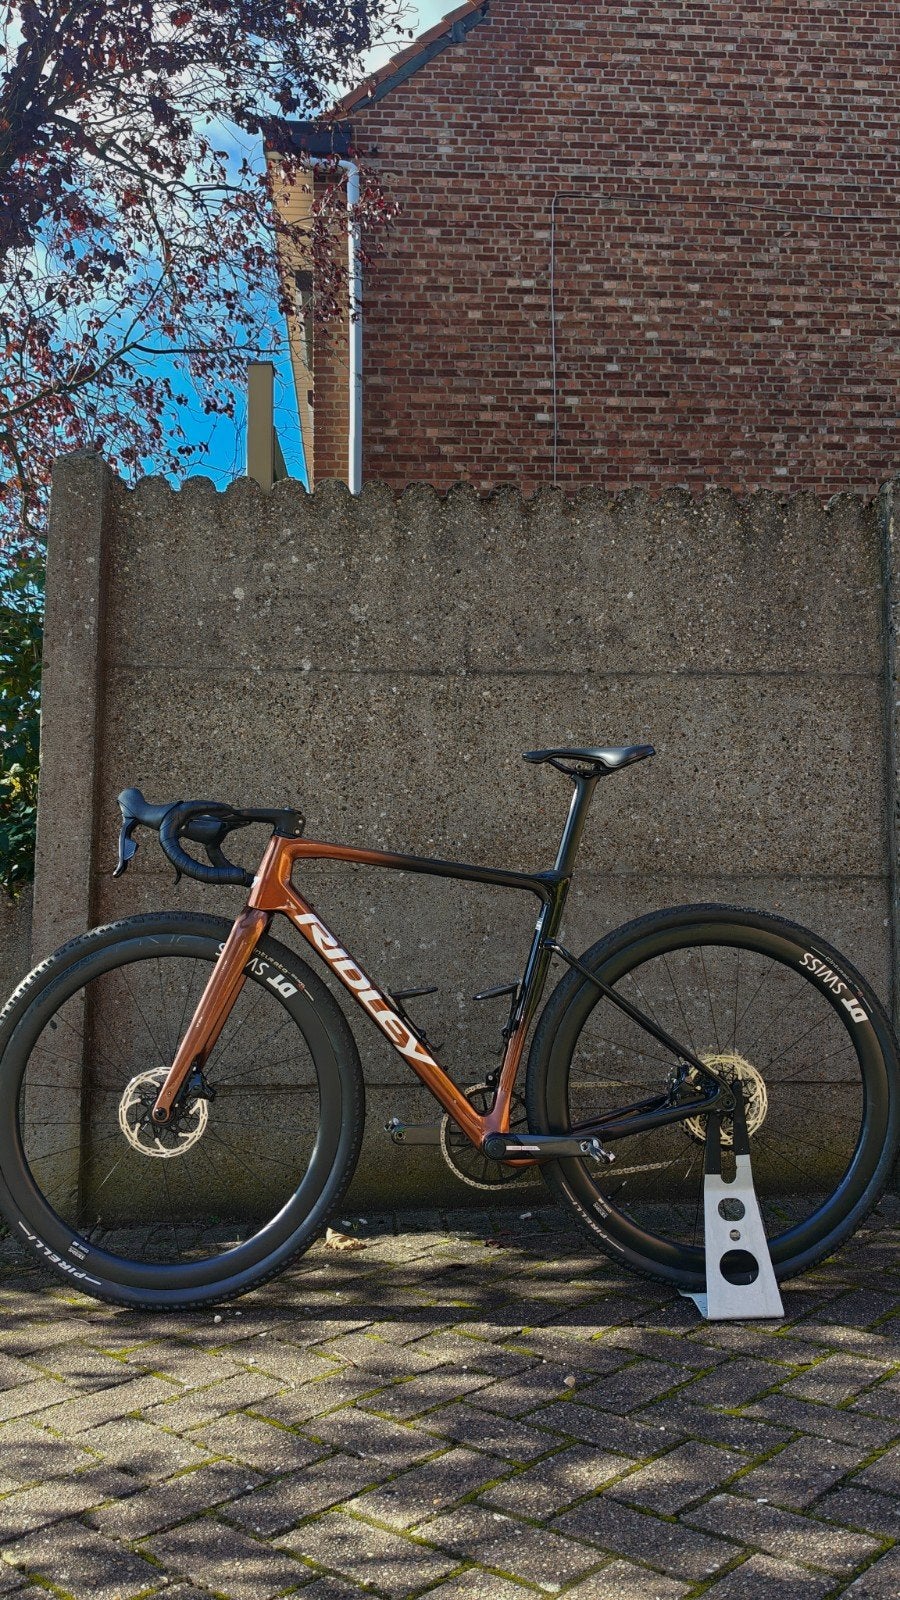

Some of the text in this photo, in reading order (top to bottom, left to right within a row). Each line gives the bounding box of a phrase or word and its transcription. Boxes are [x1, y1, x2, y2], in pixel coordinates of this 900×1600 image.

[266, 973, 298, 999] DT
[294, 913, 437, 1067] RIDLEY
[799, 952, 869, 1024] DT SWISS
[572, 1201, 608, 1239] PIRELLI
[27, 1235, 87, 1279] PIRELLI
